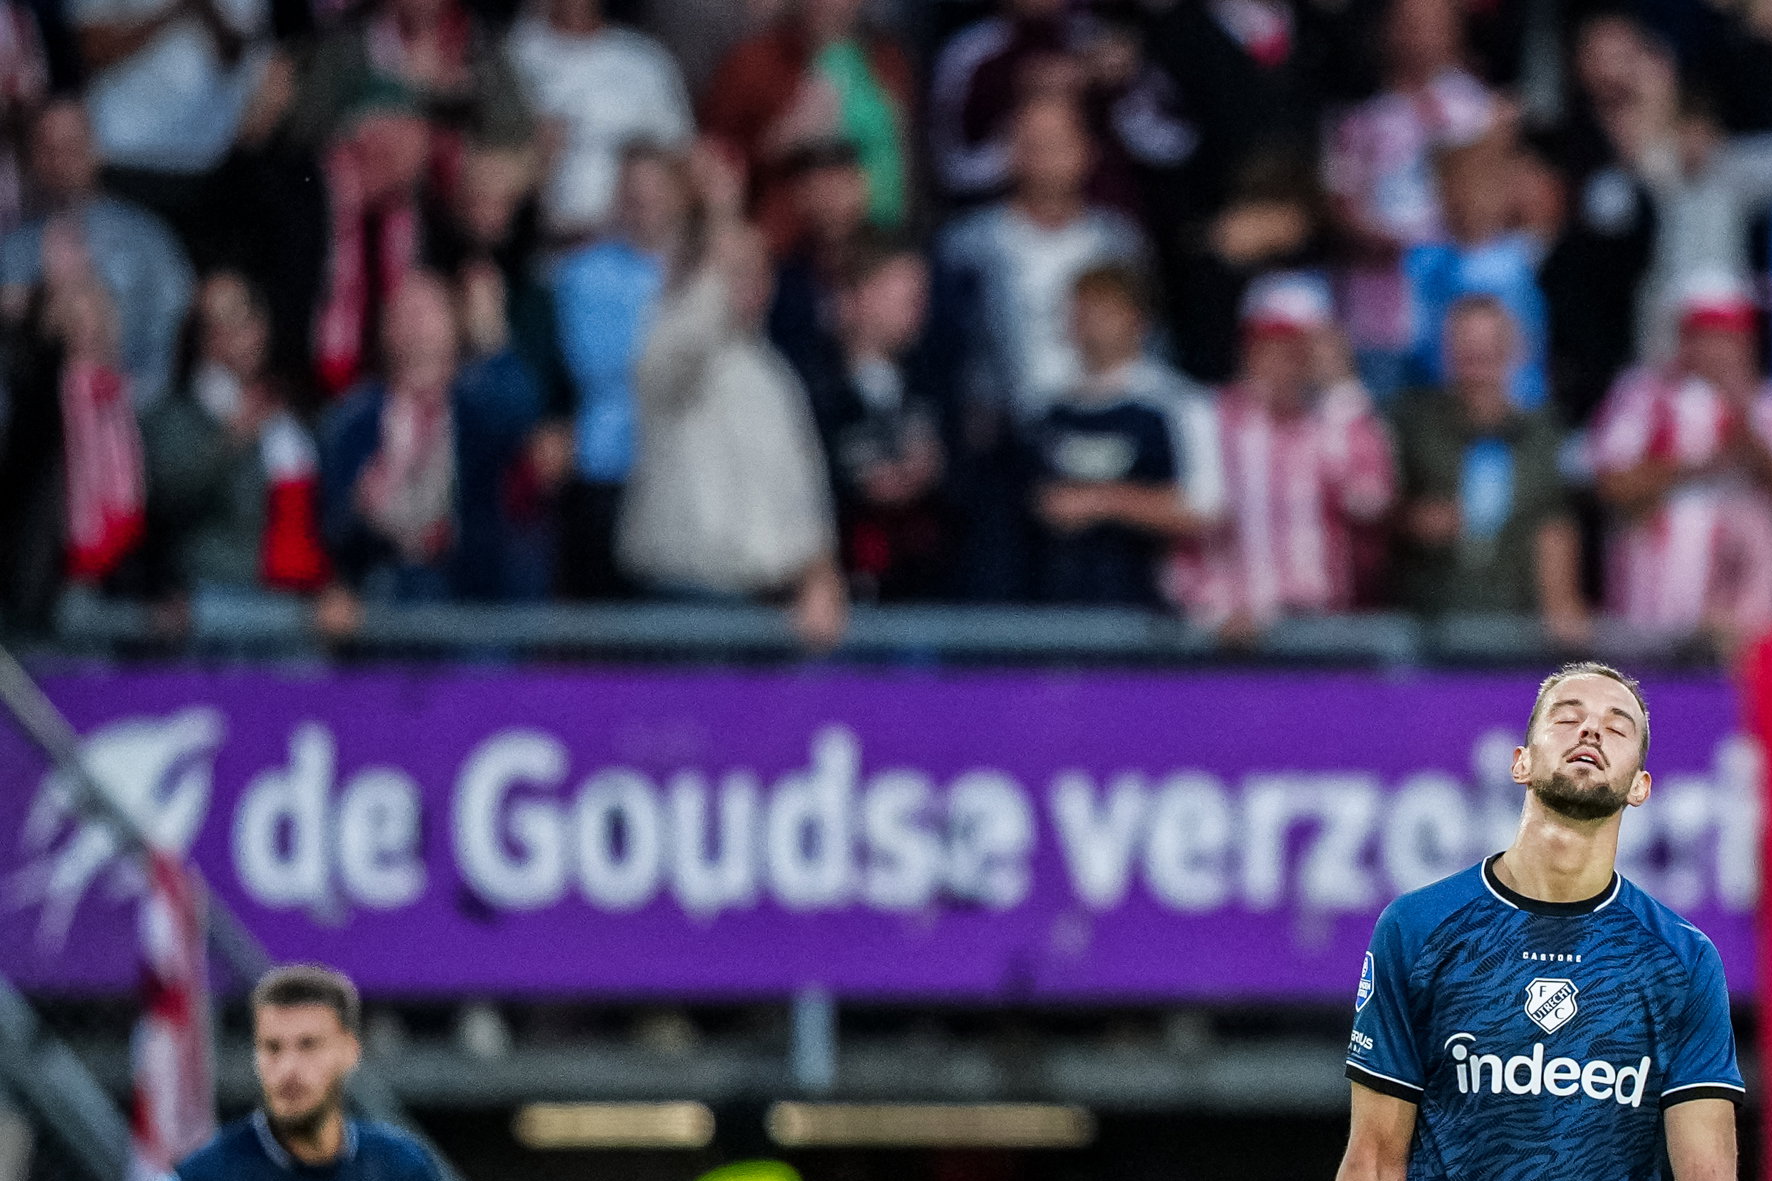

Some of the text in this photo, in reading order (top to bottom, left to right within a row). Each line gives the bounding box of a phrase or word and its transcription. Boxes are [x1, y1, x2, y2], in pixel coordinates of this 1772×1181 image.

[230, 722, 430, 912] de
[452, 724, 1034, 912] Goudse
[1522, 951, 1582, 963] CASTORE
[1532, 984, 1572, 1020] UTRECHT
[1539, 985, 1547, 998] F
[1554, 1007, 1565, 1020] C
[1444, 1032, 1652, 1108] indeed
